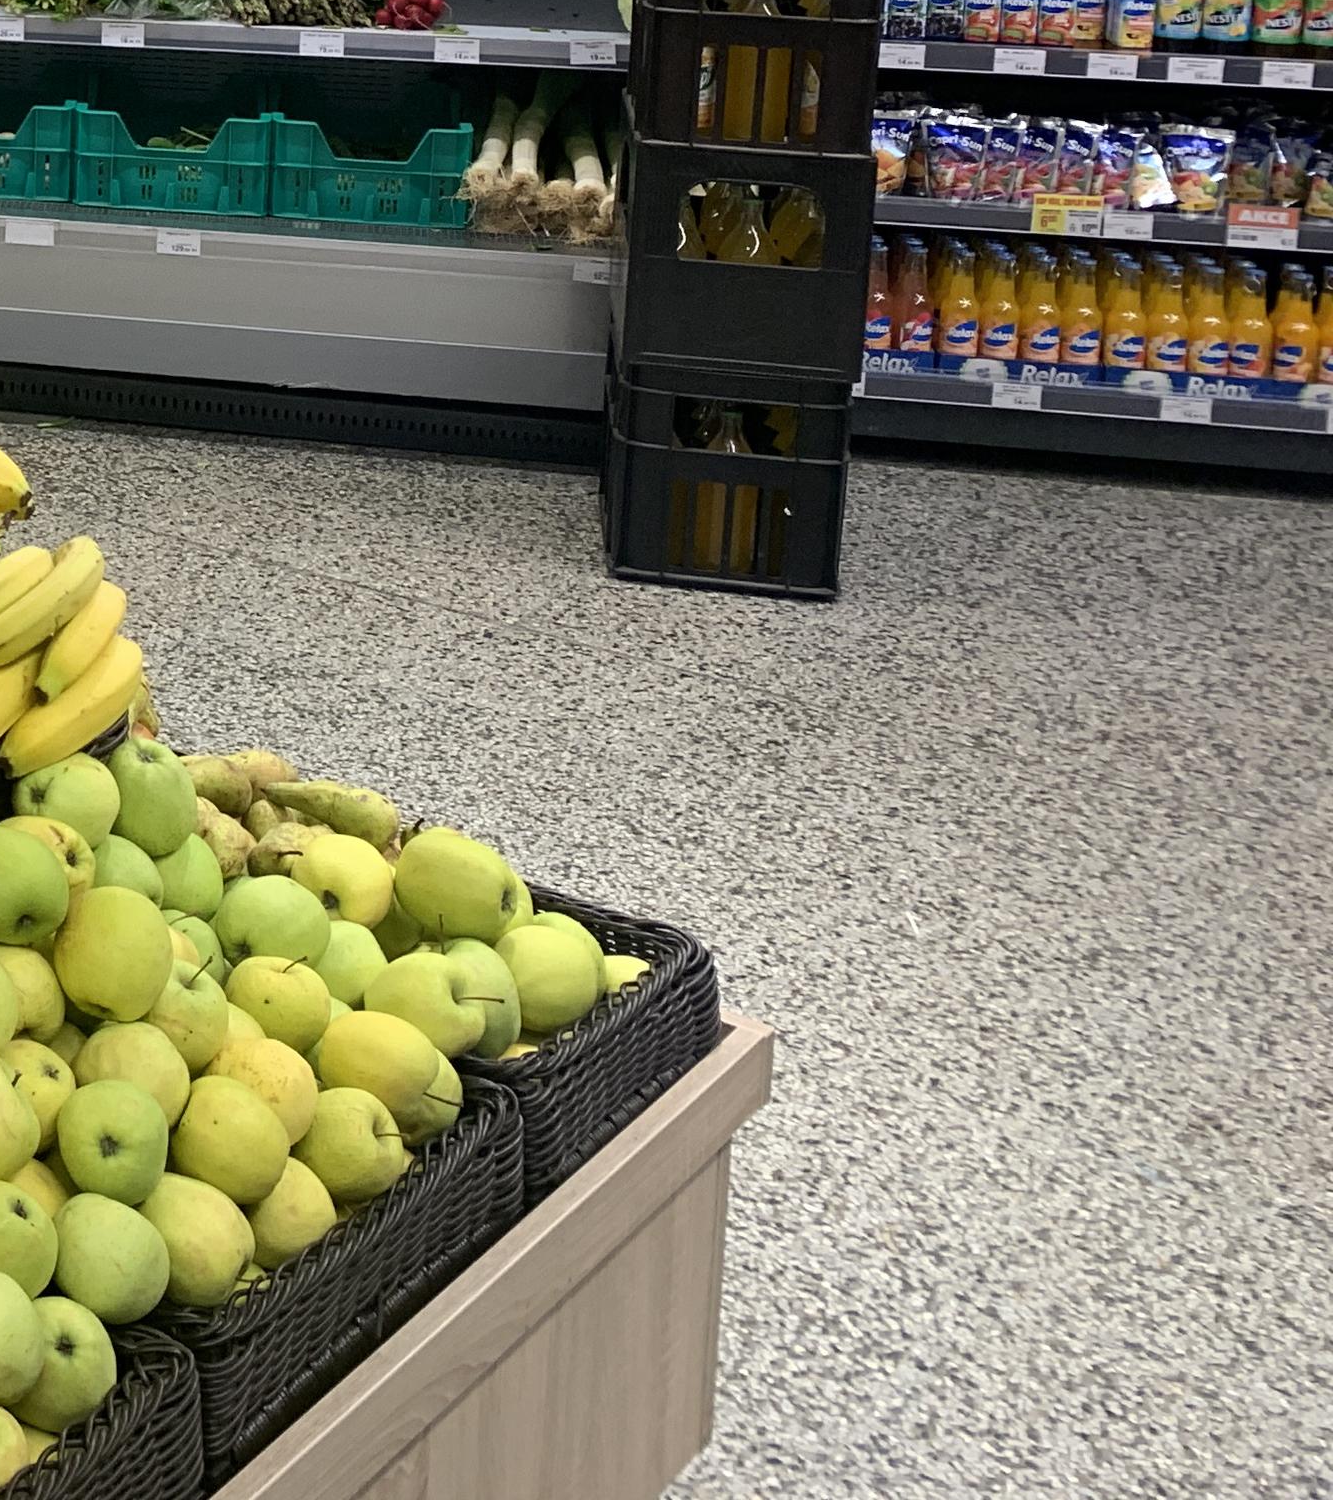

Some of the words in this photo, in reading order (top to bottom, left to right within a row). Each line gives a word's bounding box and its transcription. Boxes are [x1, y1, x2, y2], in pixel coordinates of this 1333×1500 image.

[872, 127, 911, 143] pri-Sun
[929, 136, 983, 152] Capri-Sun
[1023, 136, 1055, 154] ri-Sun
[1238, 209, 1289, 224] AKCE
[862, 351, 915, 374] Relax
[1021, 364, 1084, 387] Relax
[1187, 376, 1252, 400] Relax
